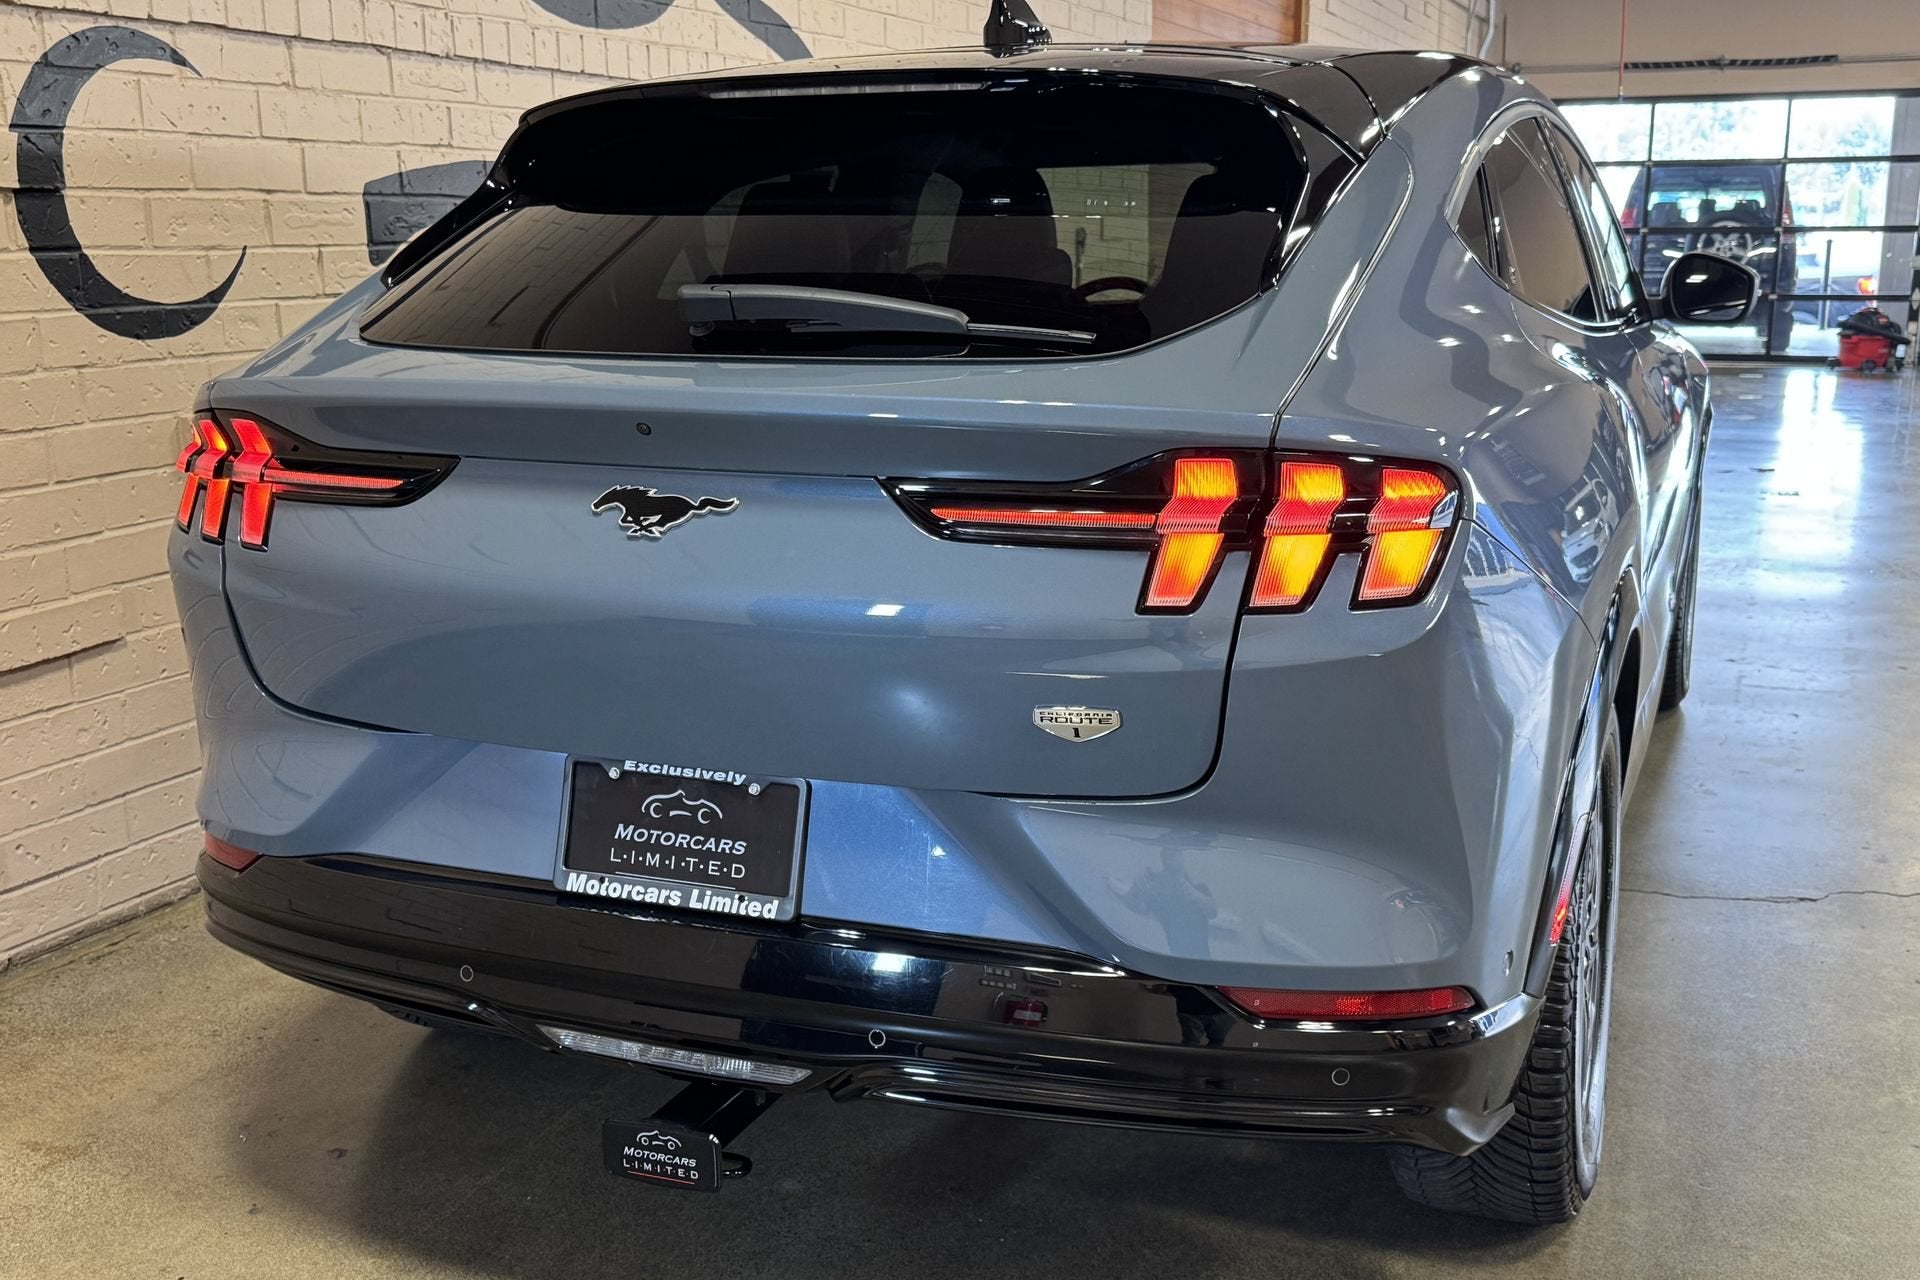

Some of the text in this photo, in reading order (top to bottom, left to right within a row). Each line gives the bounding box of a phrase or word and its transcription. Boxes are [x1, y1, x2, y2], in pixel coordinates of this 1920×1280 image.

[1040, 716, 1113, 725] ROUTE
[1072, 727, 1081, 738] 1
[623, 759, 748, 786] Exclusively
[614, 823, 748, 856] MOTORCARS
[566, 872, 780, 920] Motorcars Limited
[623, 1146, 697, 1168] MOTORCARS
